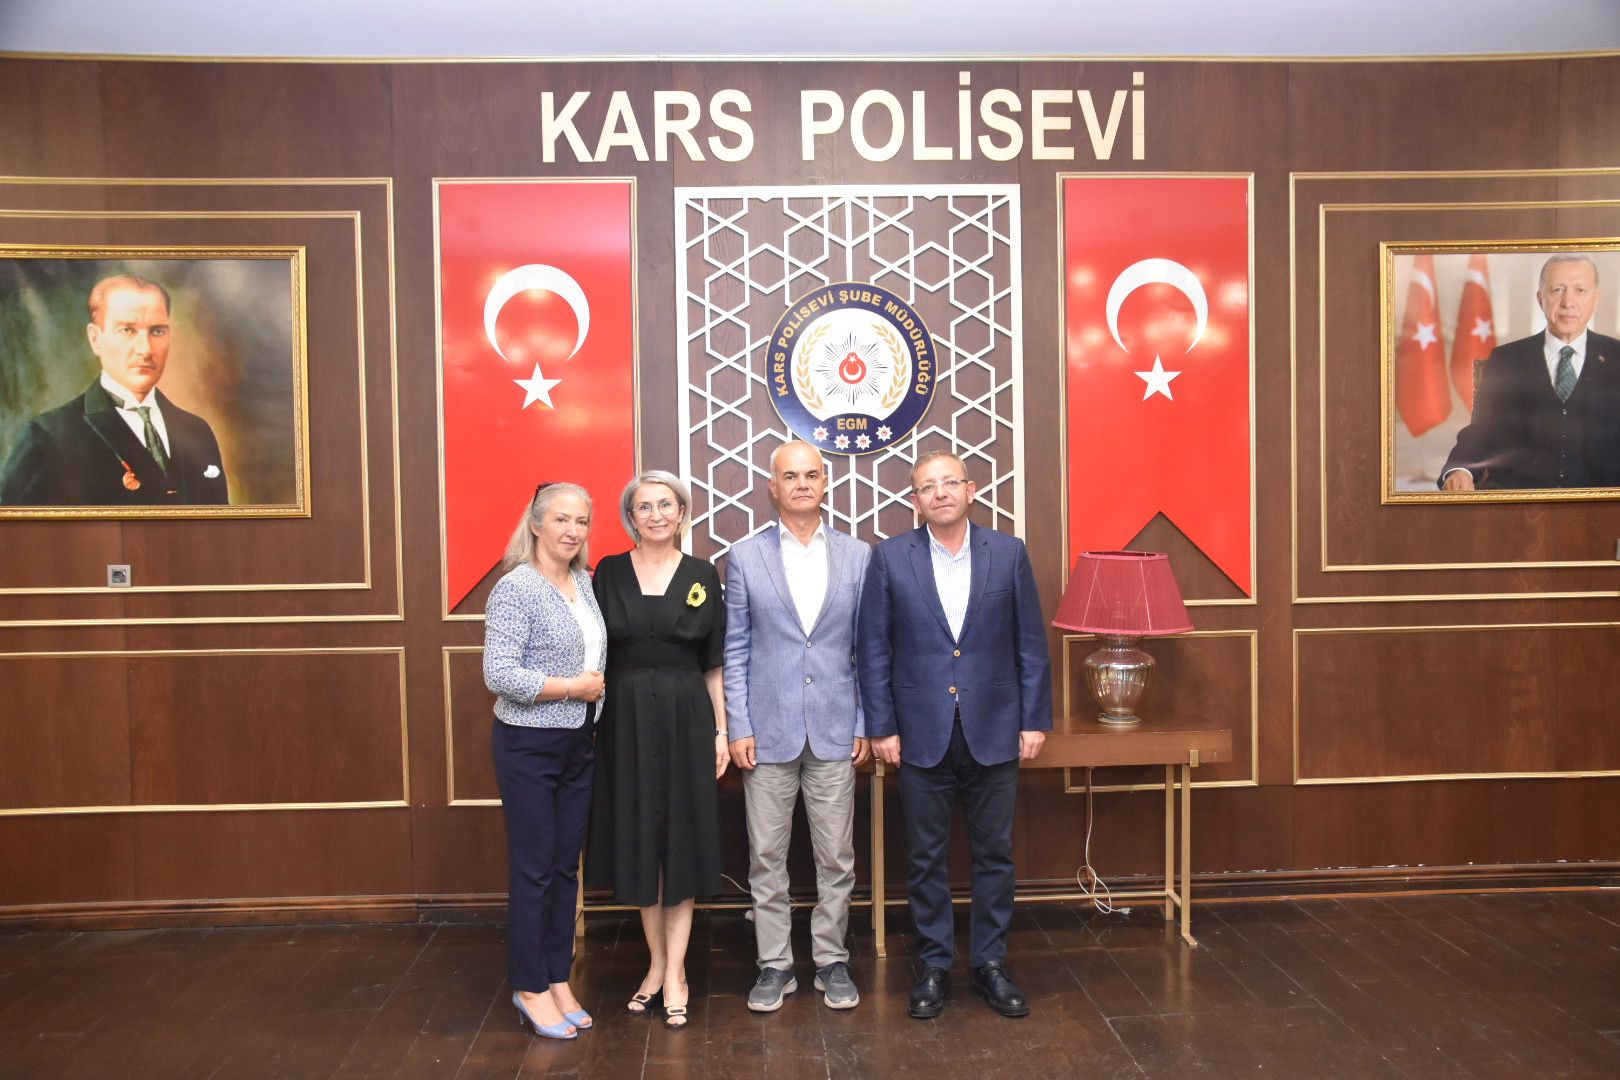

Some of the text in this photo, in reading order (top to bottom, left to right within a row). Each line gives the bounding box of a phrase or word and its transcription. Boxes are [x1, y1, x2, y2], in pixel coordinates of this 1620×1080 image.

[540, 71, 1146, 164] KARS POLİSEVİ
[773, 289, 932, 397] KARS POLİSEVİ ŞUBE MÜDÜRLÜĞÜ
[836, 417, 868, 430] EGM
